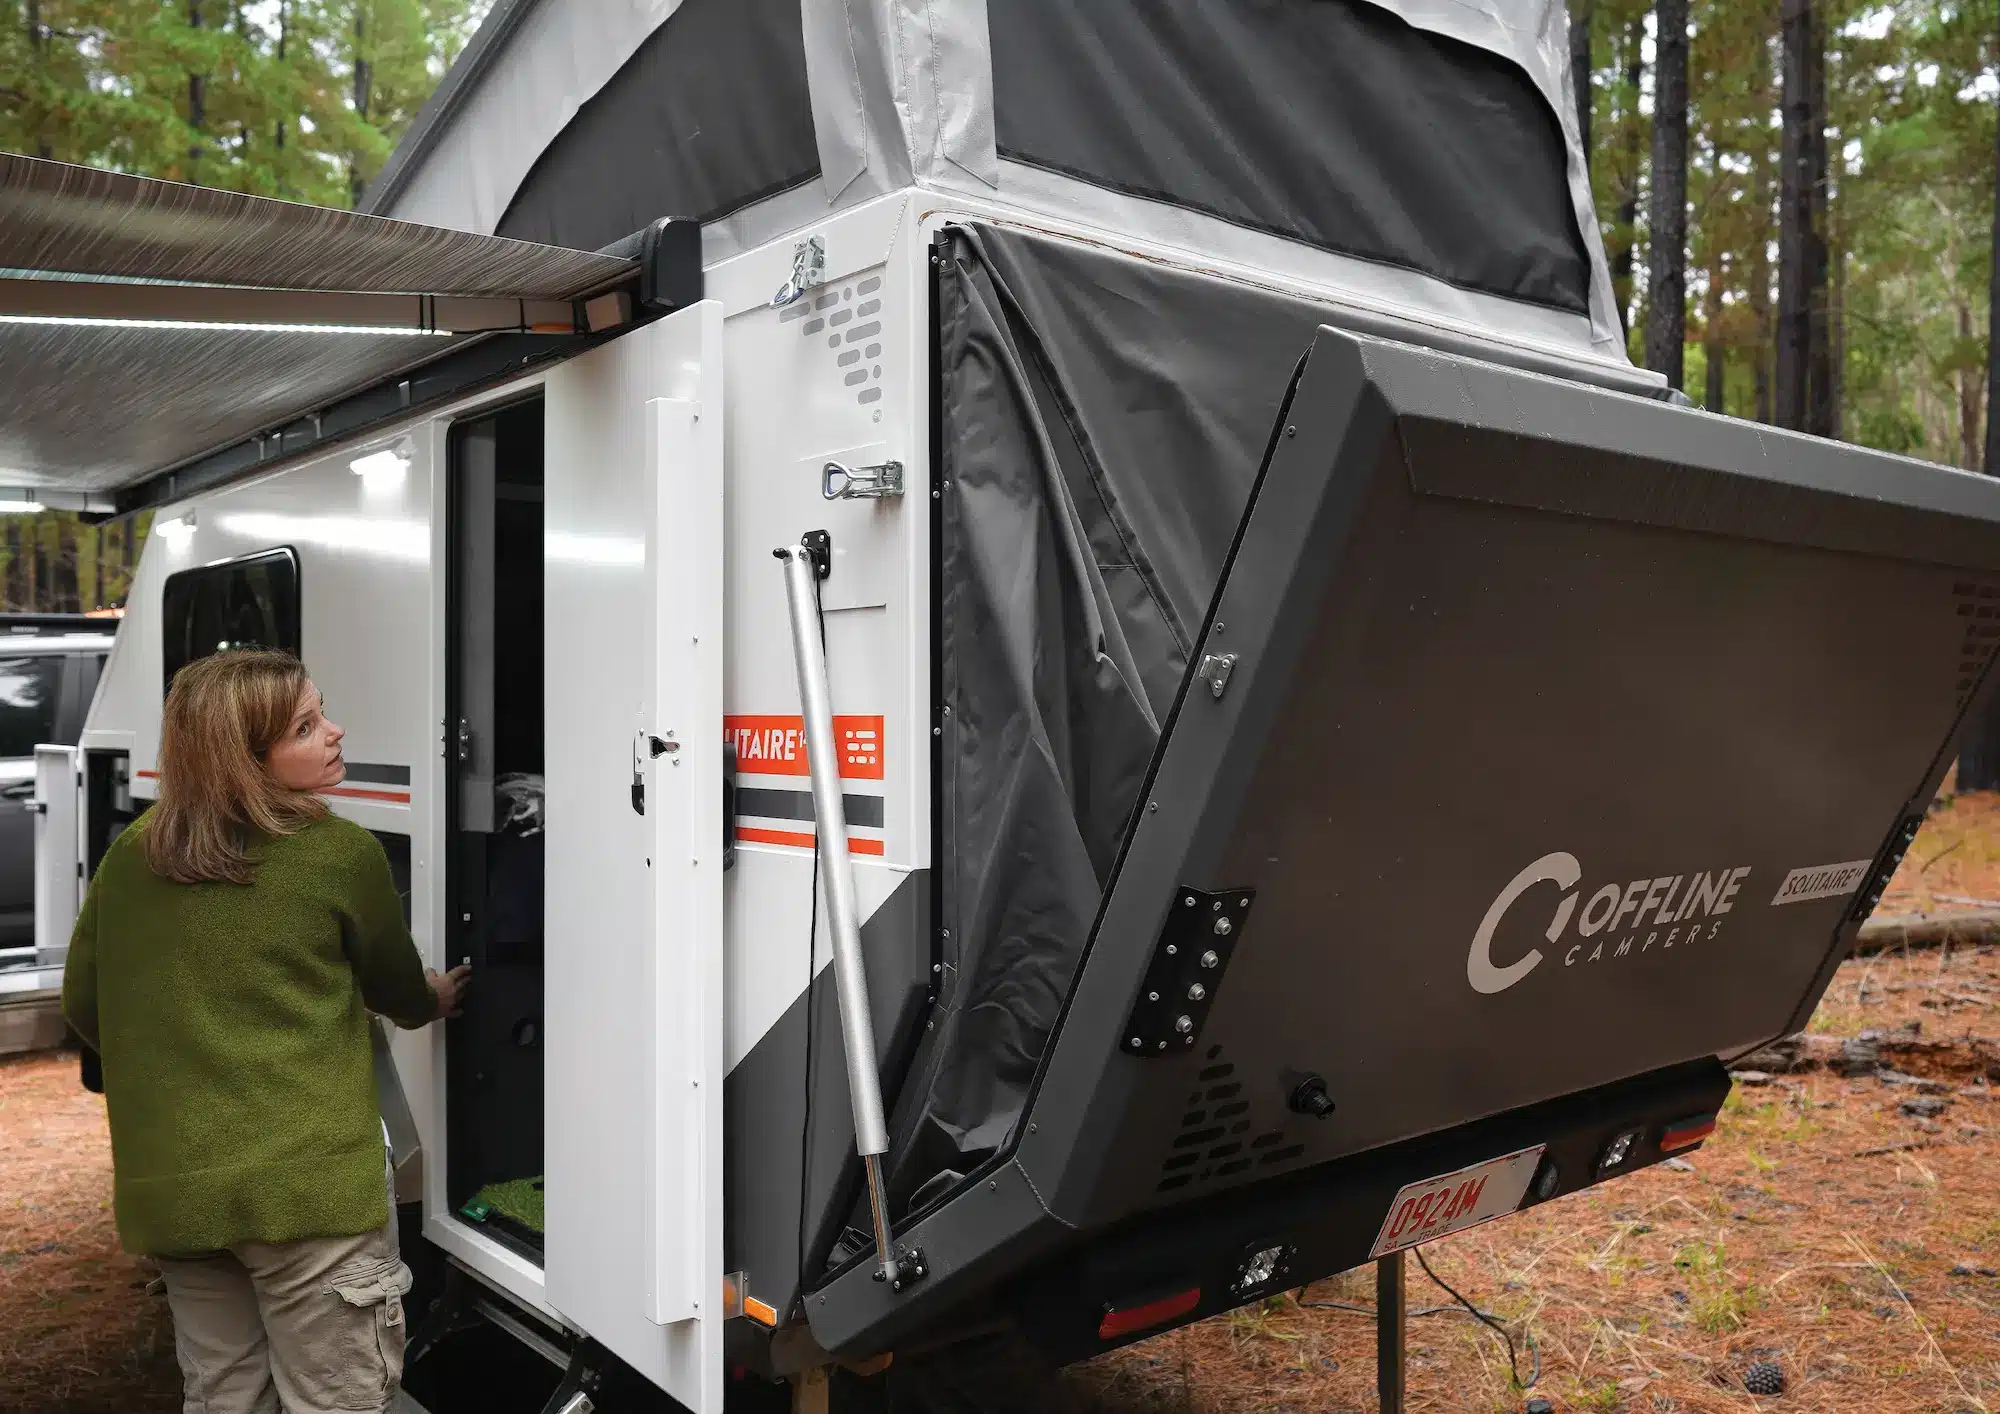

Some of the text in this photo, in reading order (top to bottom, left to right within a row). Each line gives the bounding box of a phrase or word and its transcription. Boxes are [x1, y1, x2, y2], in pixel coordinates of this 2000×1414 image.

[1578, 865, 1752, 938] OFFLINE
[1564, 920, 1722, 967] CAMPERS
[1387, 1173, 1490, 1240] 0924M
[1418, 1223, 1453, 1242] TRADE
